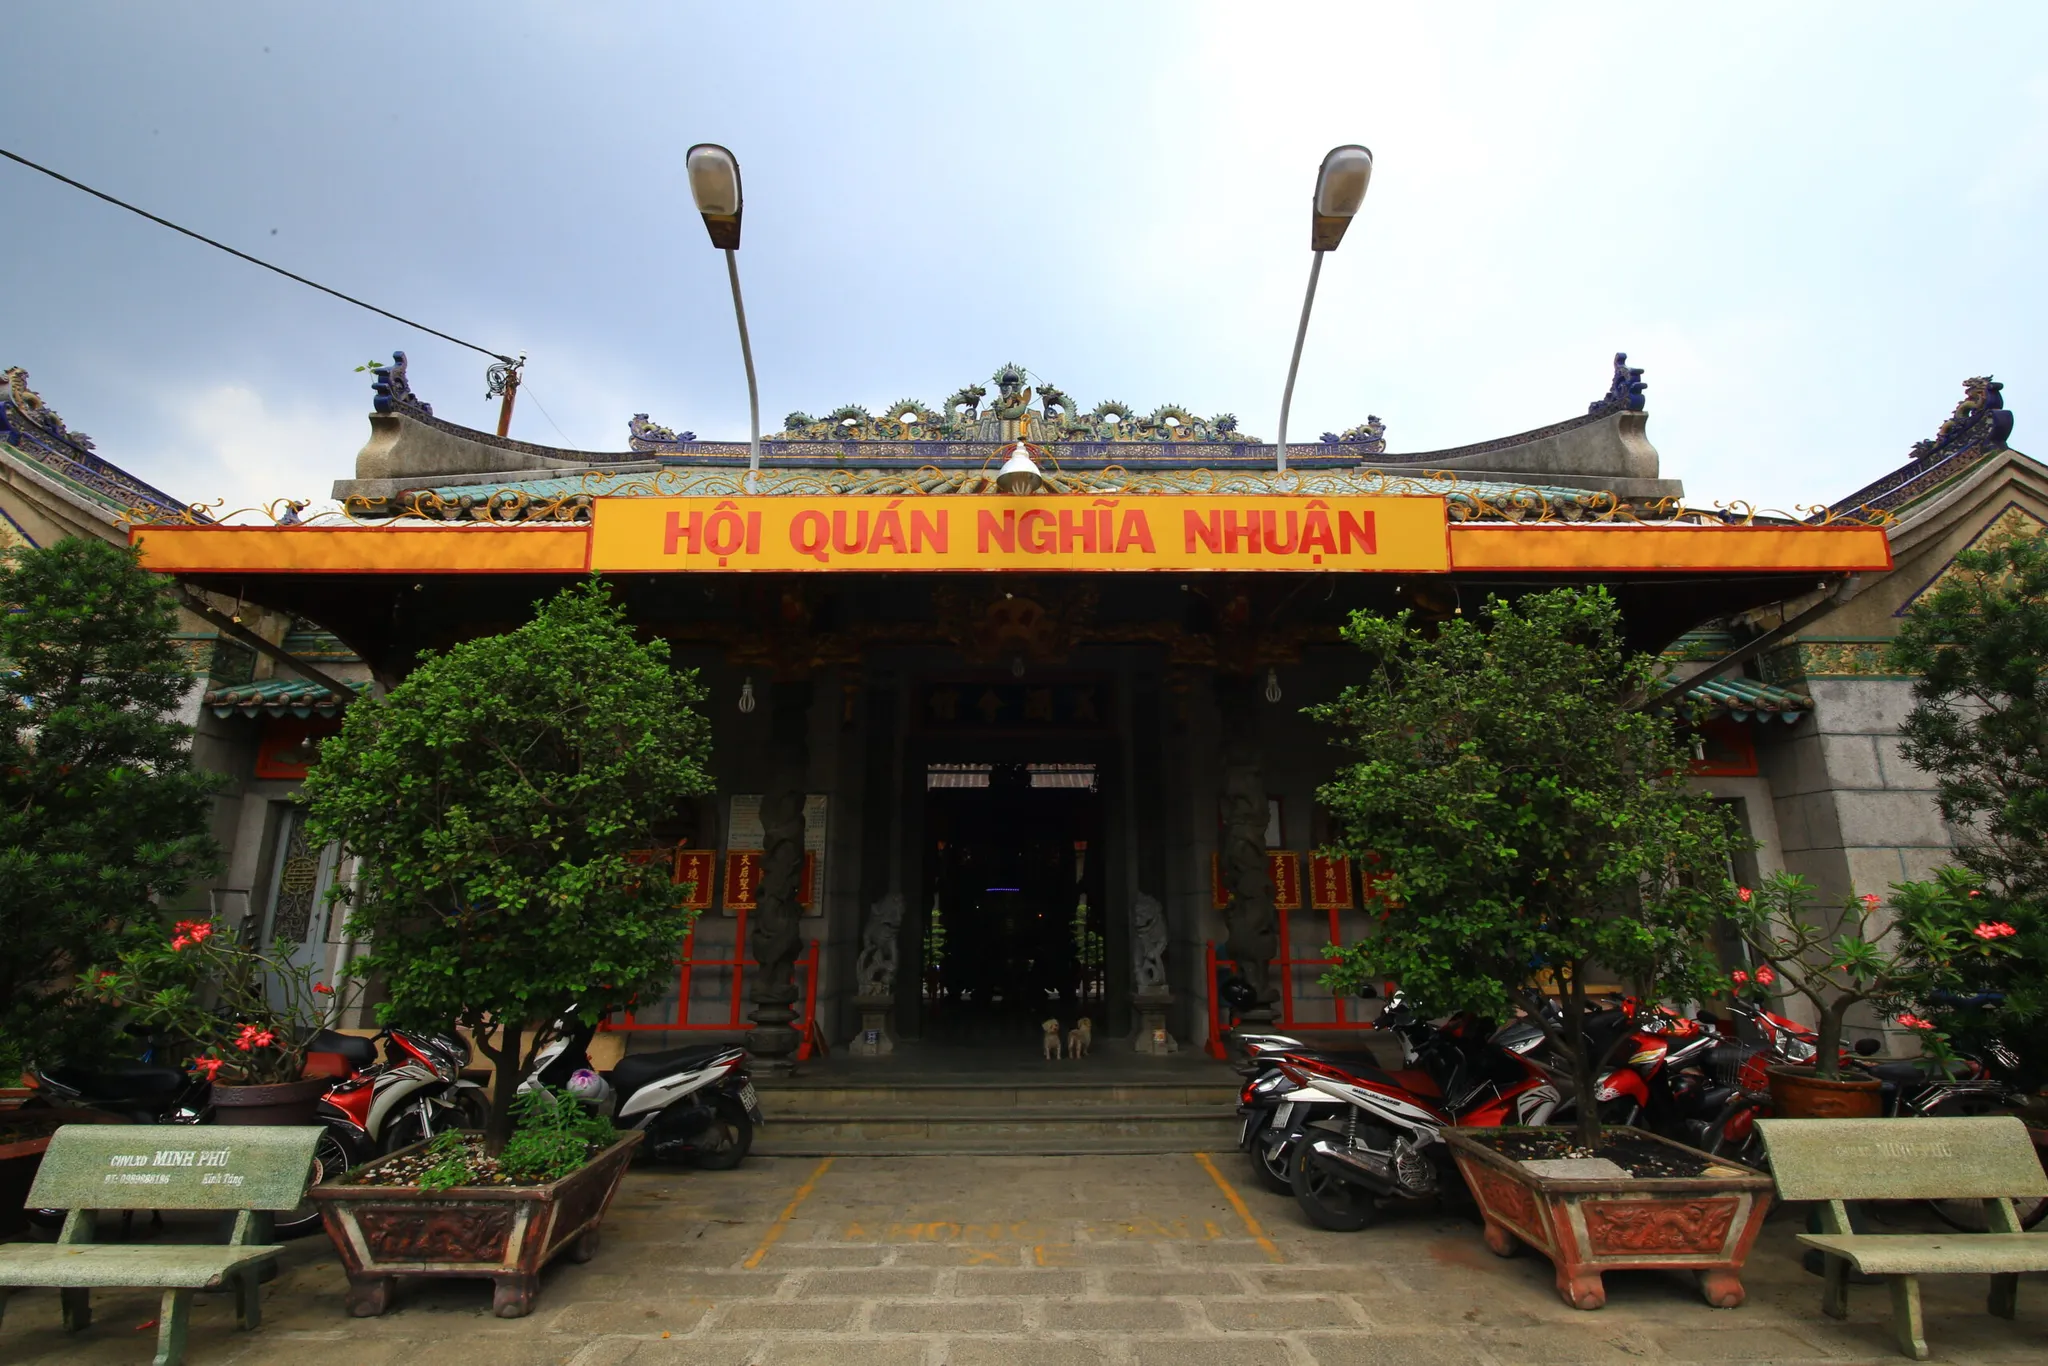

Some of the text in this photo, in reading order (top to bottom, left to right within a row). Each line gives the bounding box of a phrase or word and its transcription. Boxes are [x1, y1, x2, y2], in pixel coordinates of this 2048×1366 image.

[663, 500, 1377, 566] HỘI QUÁN NGHĨA NHUẬN
[152, 1150, 197, 1167] MINH
[197, 1146, 231, 1167] PHÚ
